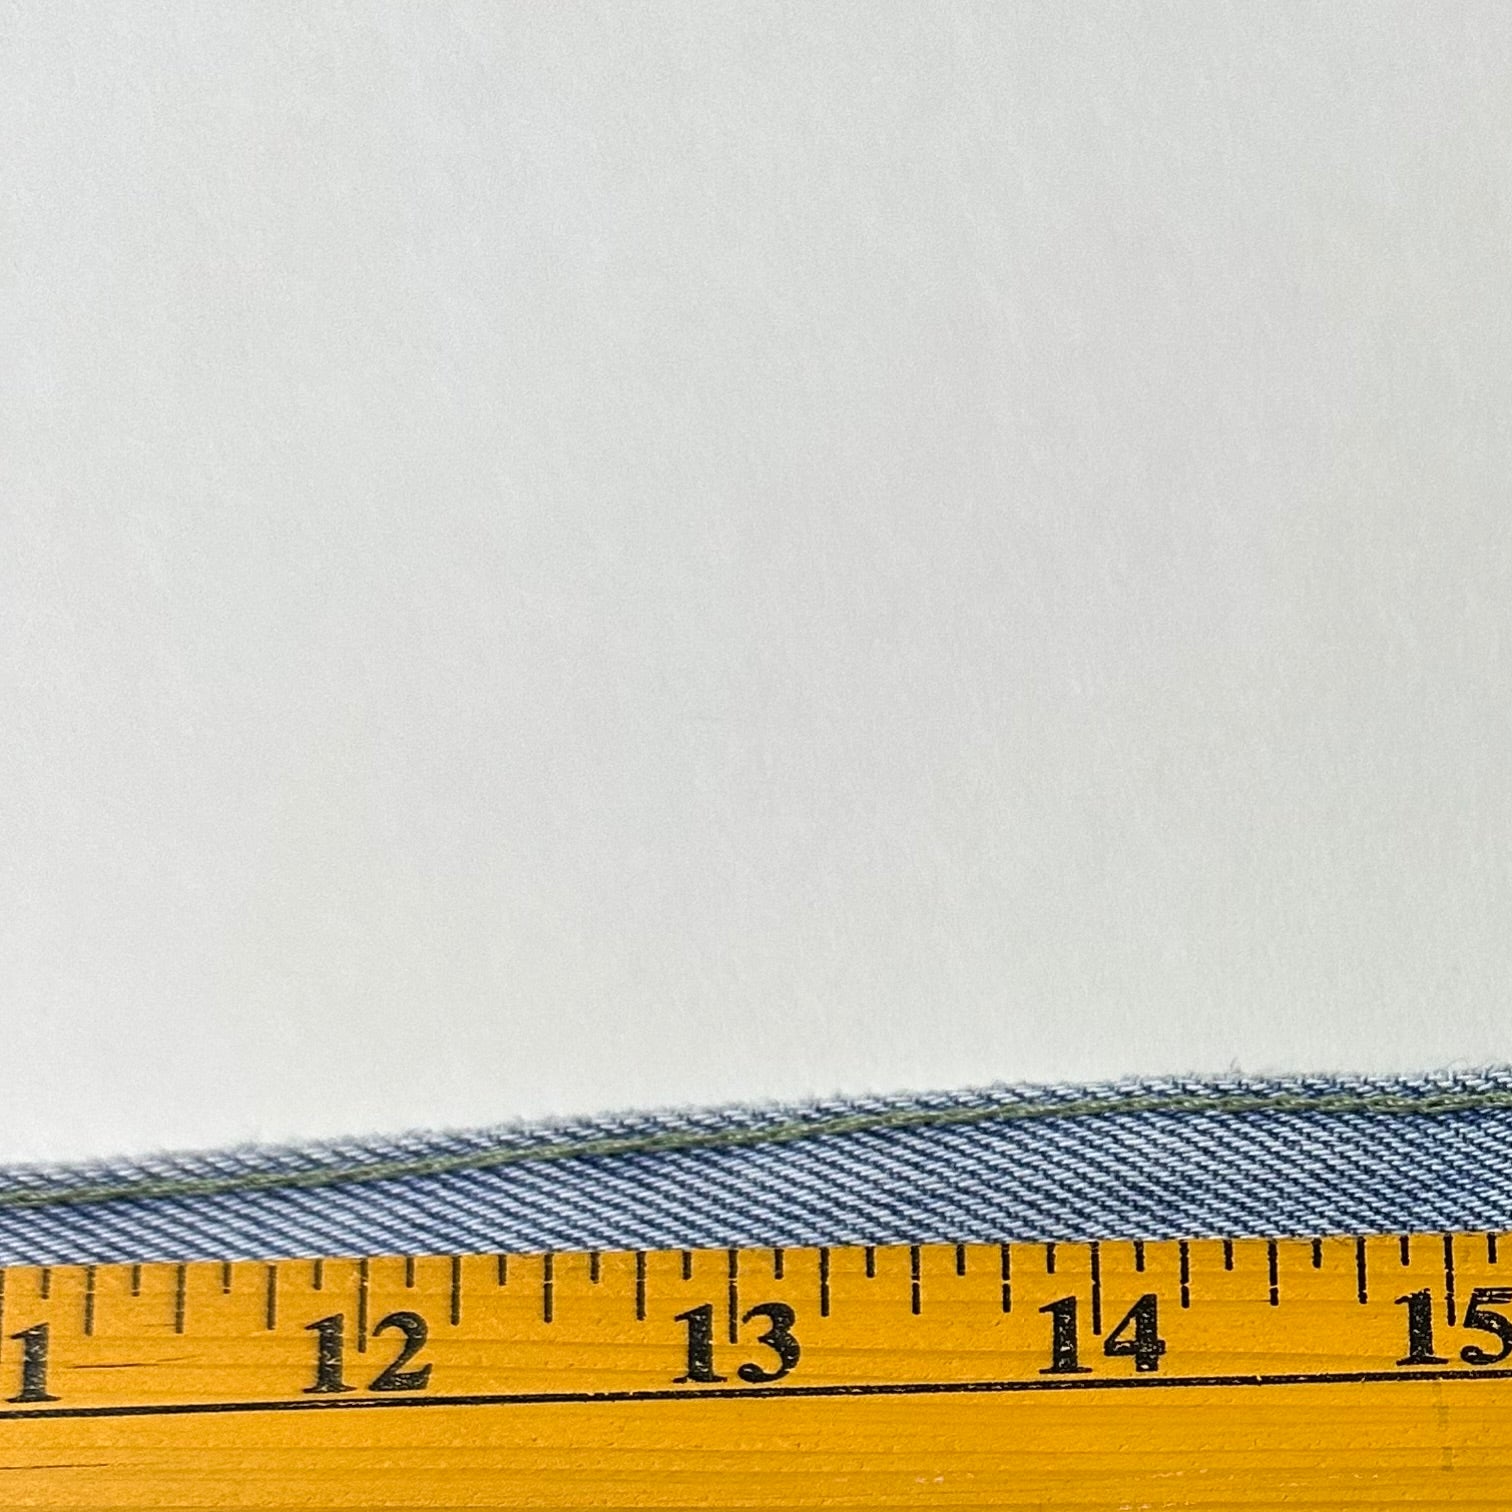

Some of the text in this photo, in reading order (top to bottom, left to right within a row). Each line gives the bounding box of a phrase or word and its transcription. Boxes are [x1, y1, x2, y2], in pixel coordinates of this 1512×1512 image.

[5, 1322, 62, 1404] 1
[302, 1311, 432, 1393] 12
[673, 1302, 800, 1385] 13
[1038, 1293, 1167, 1373] 14
